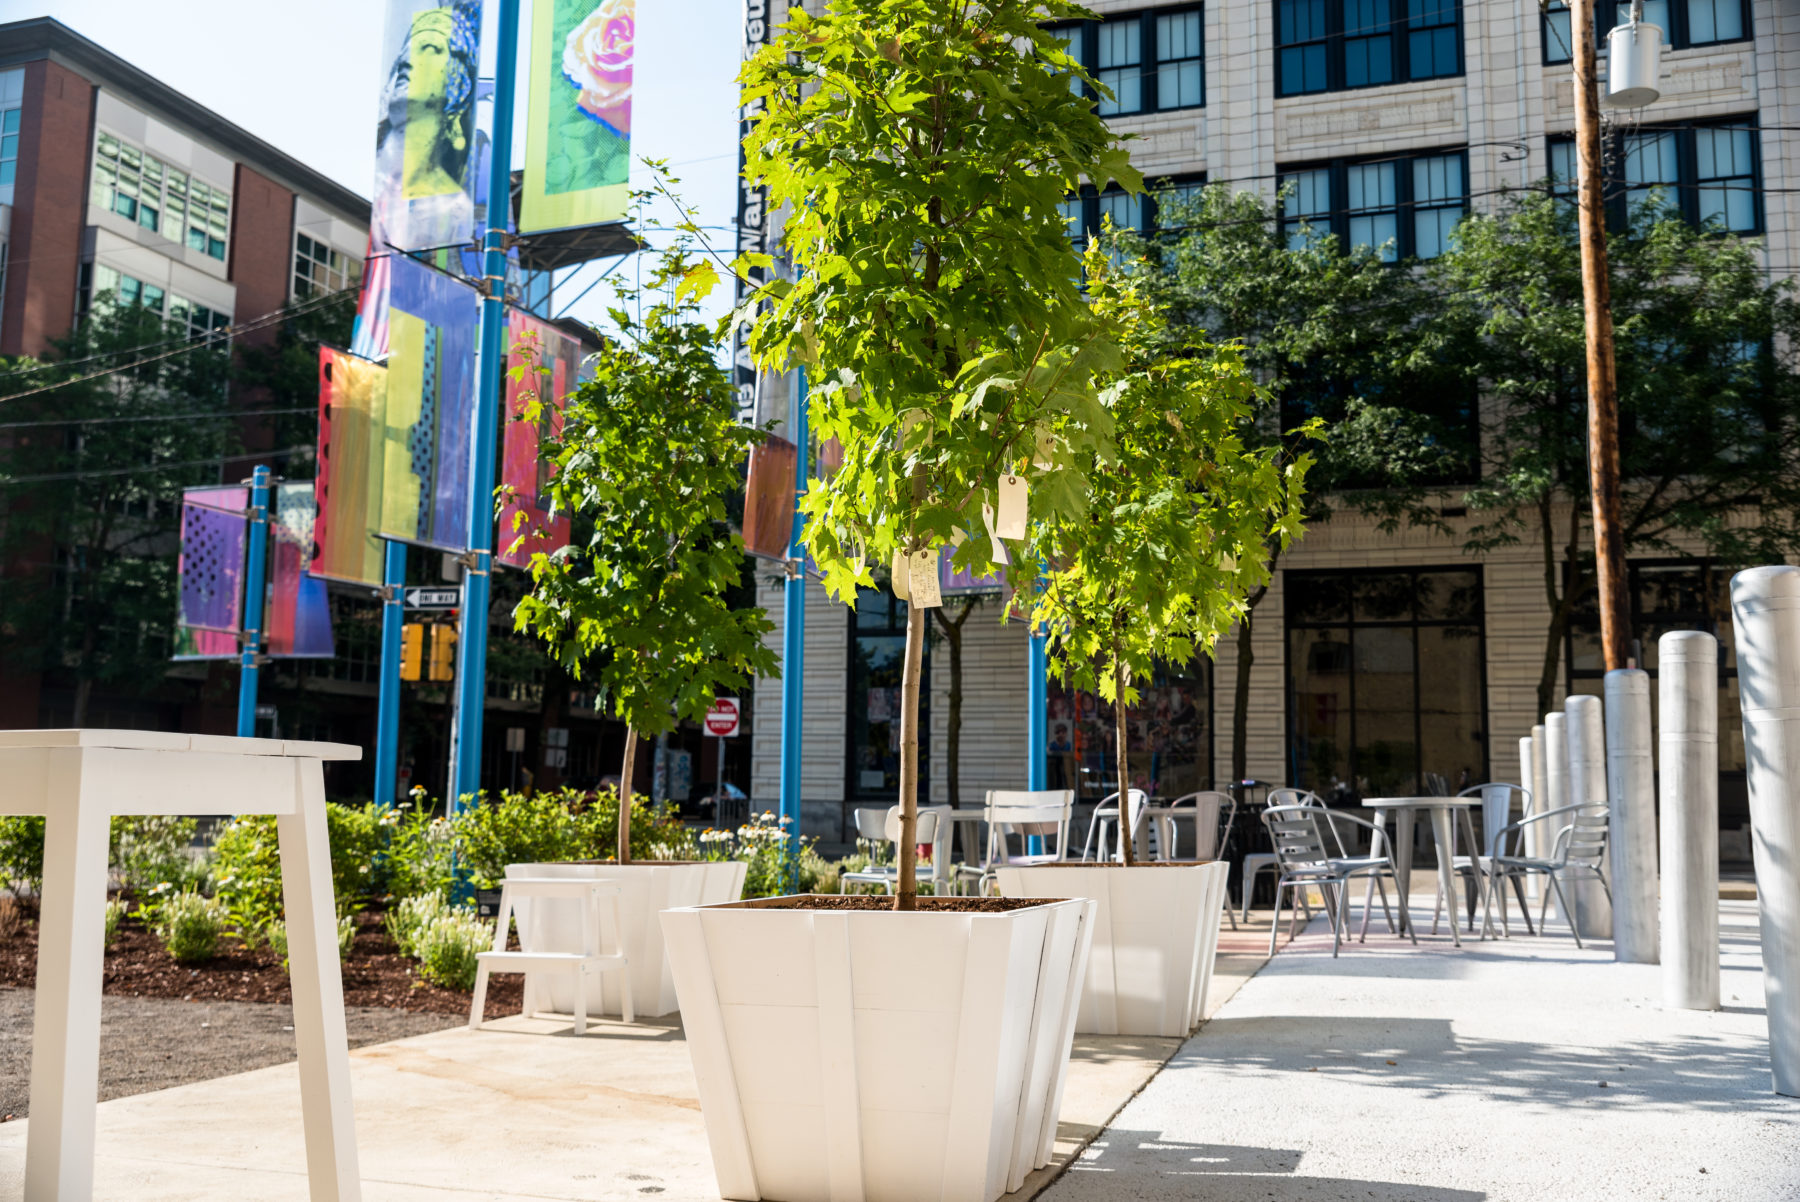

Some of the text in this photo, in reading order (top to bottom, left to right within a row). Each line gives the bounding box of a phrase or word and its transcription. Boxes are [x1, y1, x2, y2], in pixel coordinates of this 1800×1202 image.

[734, 274, 763, 372] Any
[420, 593, 453, 602] ONE WAY
